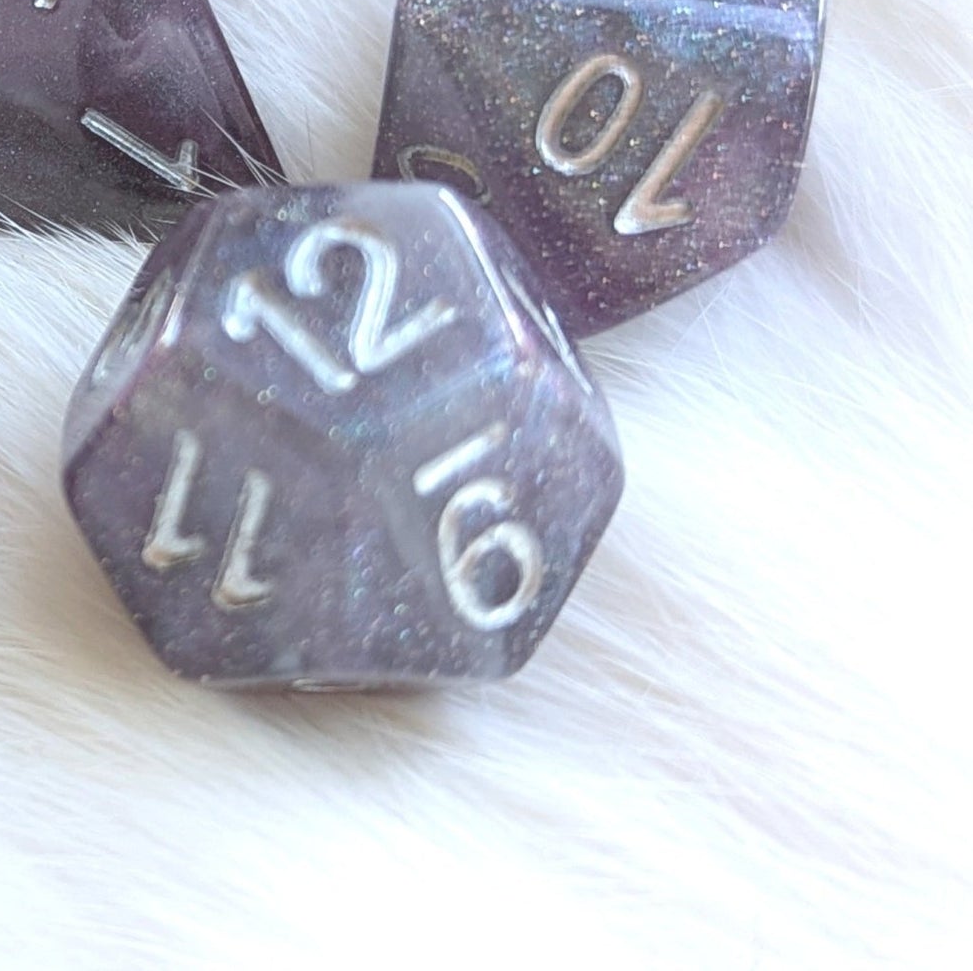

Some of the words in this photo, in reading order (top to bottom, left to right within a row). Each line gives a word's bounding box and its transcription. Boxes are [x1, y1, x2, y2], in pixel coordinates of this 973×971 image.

[535, 54, 724, 236] 10
[221, 219, 458, 395] 12
[142, 427, 275, 612] 11
